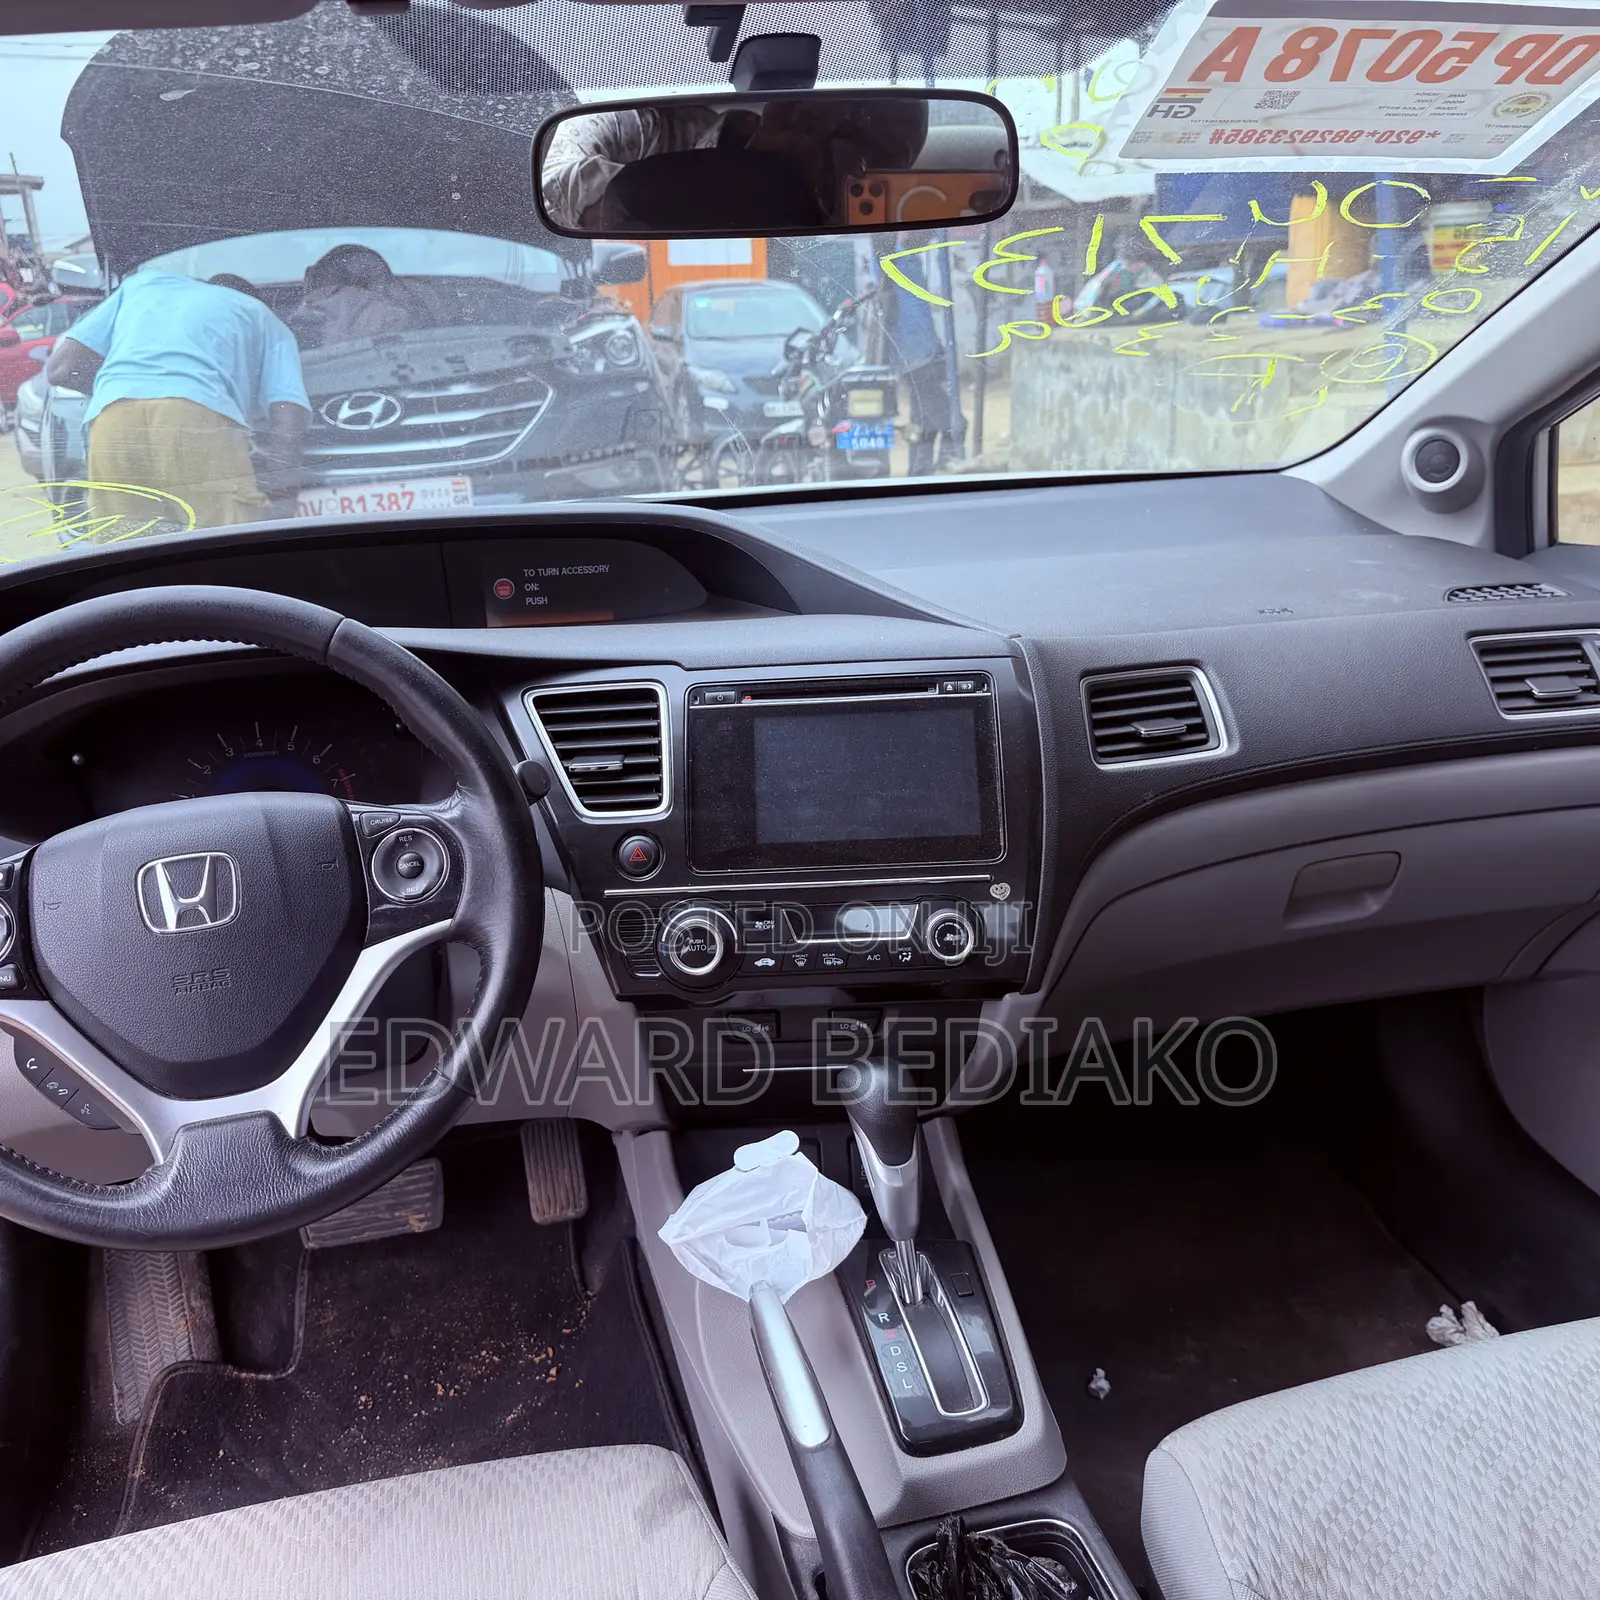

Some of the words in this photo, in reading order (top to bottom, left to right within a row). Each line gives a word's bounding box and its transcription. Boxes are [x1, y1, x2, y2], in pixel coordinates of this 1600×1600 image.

[523, 569, 535, 577] TO
[538, 567, 559, 576] TURN
[562, 564, 610, 575] ACCESSORY
[526, 597, 548, 605] PUSH
[287, 741, 294, 751] 5
[225, 748, 234, 757] 3
[312, 755, 320, 764] 6
[203, 765, 212, 775] 2
[370, 818, 394, 826] CRUISE
[398, 861, 421, 869] CANCEL
[686, 944, 707, 952] AUTO
[172, 968, 231, 984] SRS
[175, 979, 232, 995] AIRBAG
[878, 1313, 890, 1323] R
[890, 1345, 901, 1356] D
[896, 1362, 907, 1372] S
[902, 1379, 912, 1389] L
